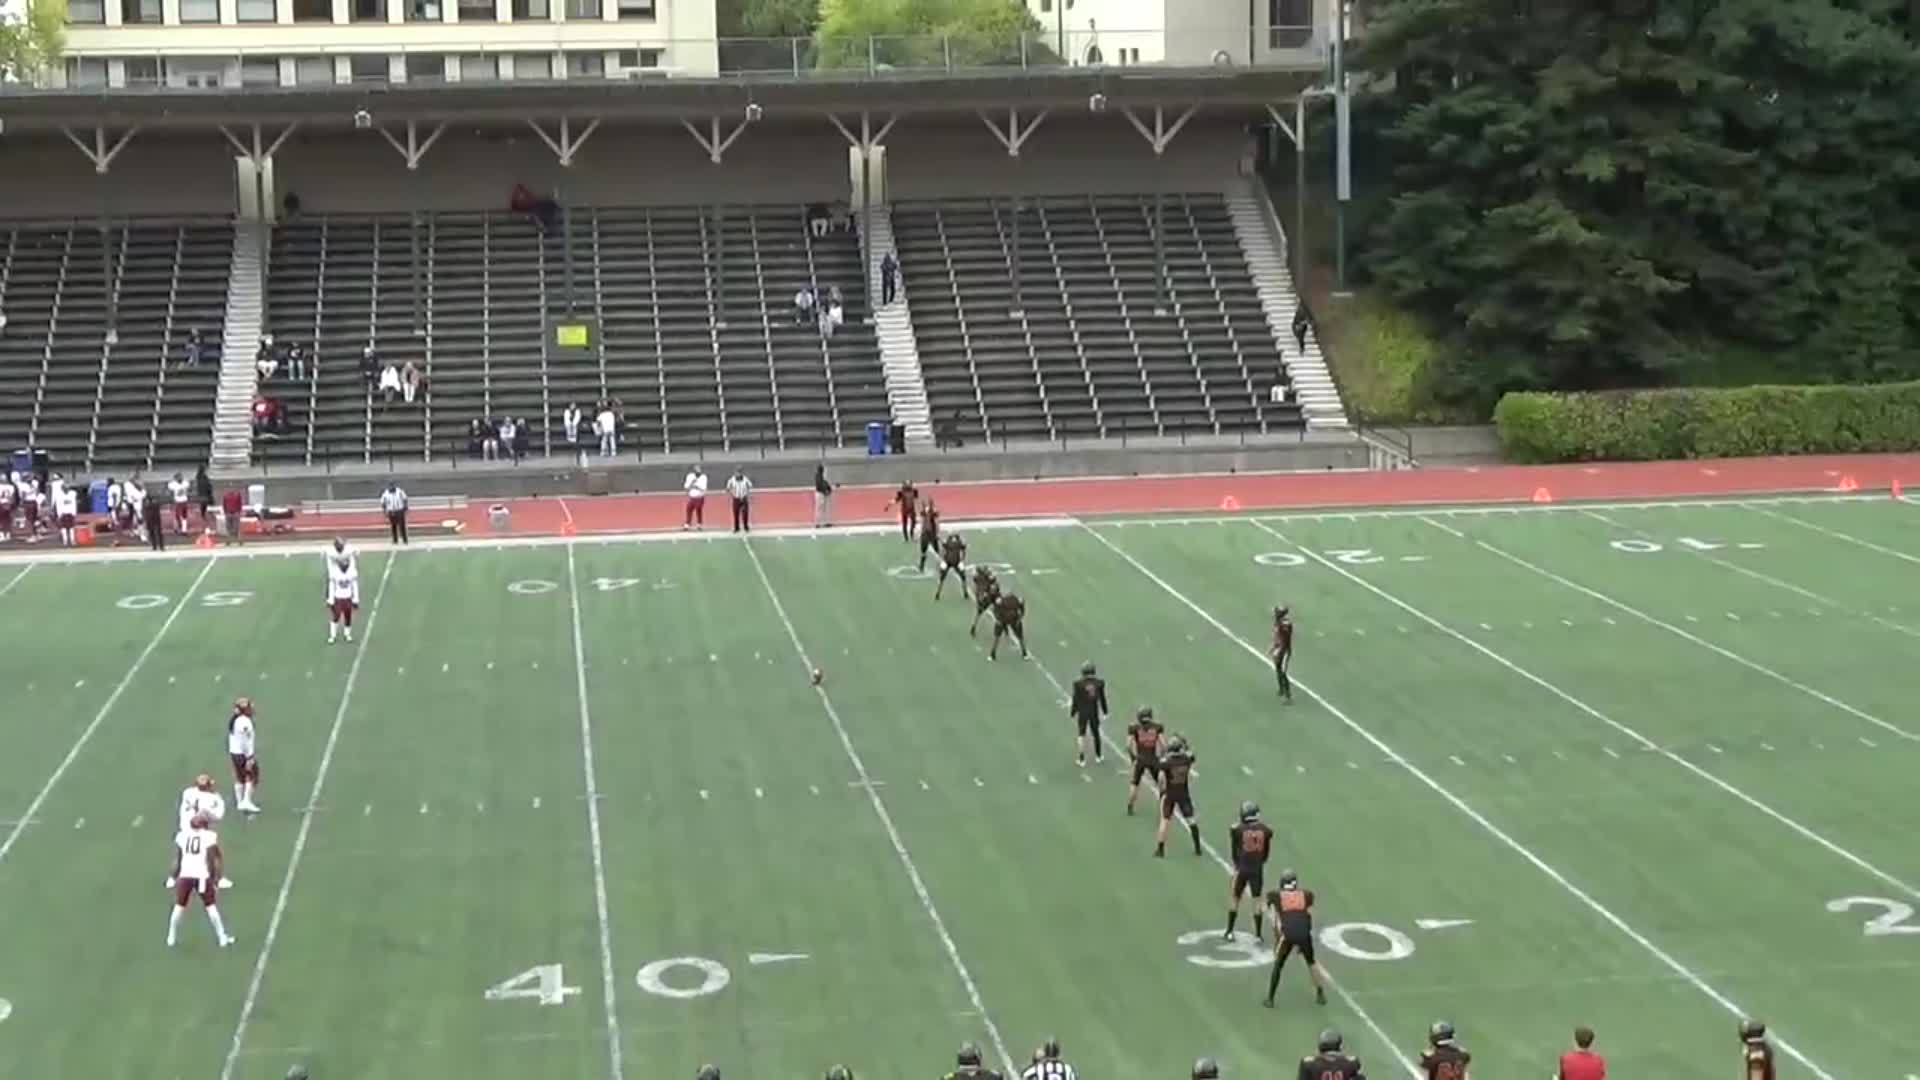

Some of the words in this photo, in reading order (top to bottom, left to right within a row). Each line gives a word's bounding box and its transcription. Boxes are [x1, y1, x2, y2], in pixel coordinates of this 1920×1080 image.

[185, 836, 201, 855] 10
[1177, 922, 1416, 968] 30
[484, 956, 730, 1005] 40
